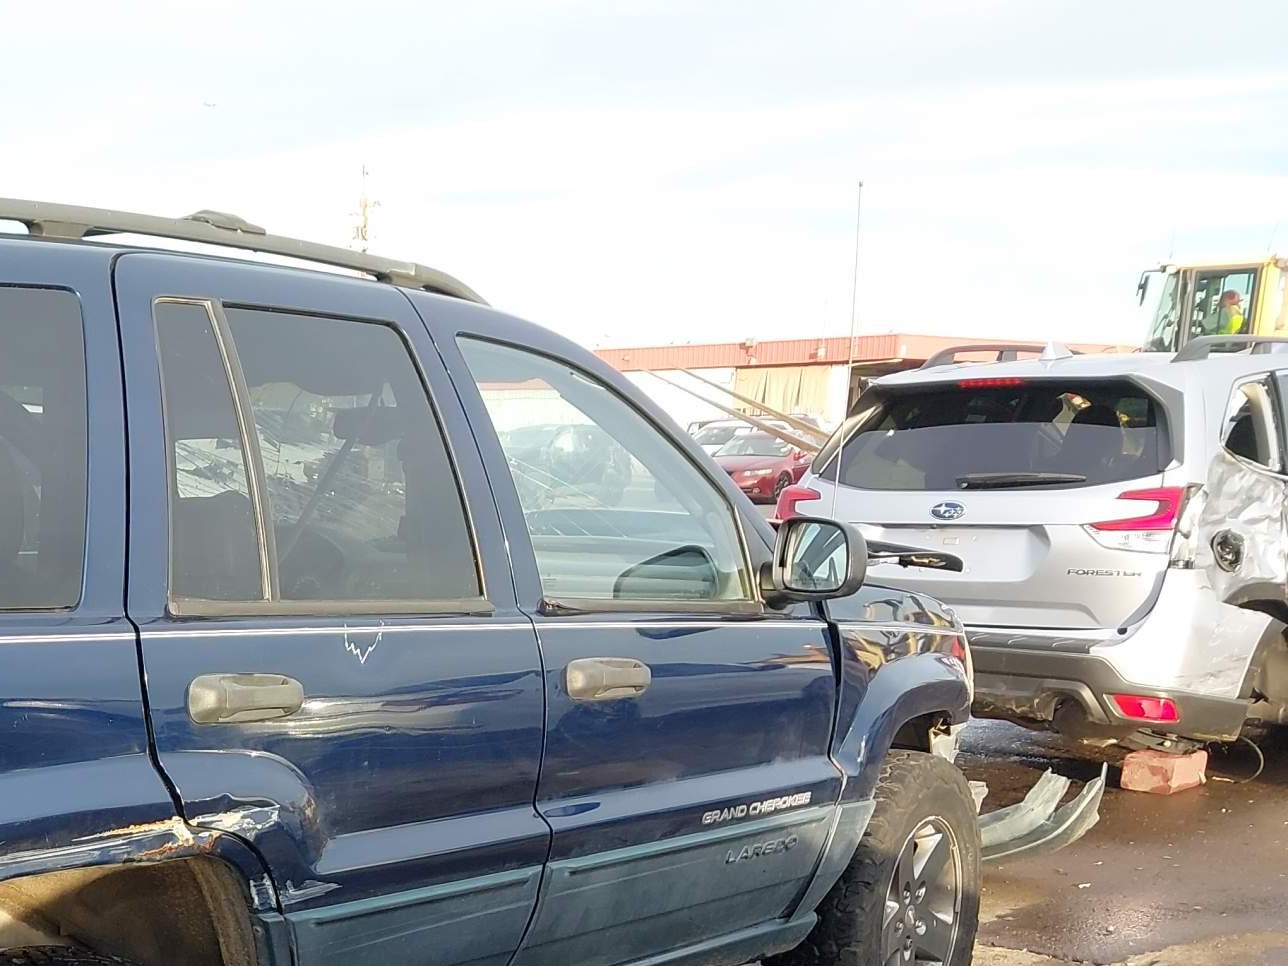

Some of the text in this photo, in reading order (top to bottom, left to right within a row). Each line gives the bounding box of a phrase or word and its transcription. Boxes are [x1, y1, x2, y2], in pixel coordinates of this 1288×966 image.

[1066, 568, 1143, 577] FORESTER
[702, 791, 812, 824] GRAND CHEROKEE
[725, 835, 799, 864] LAREDO
